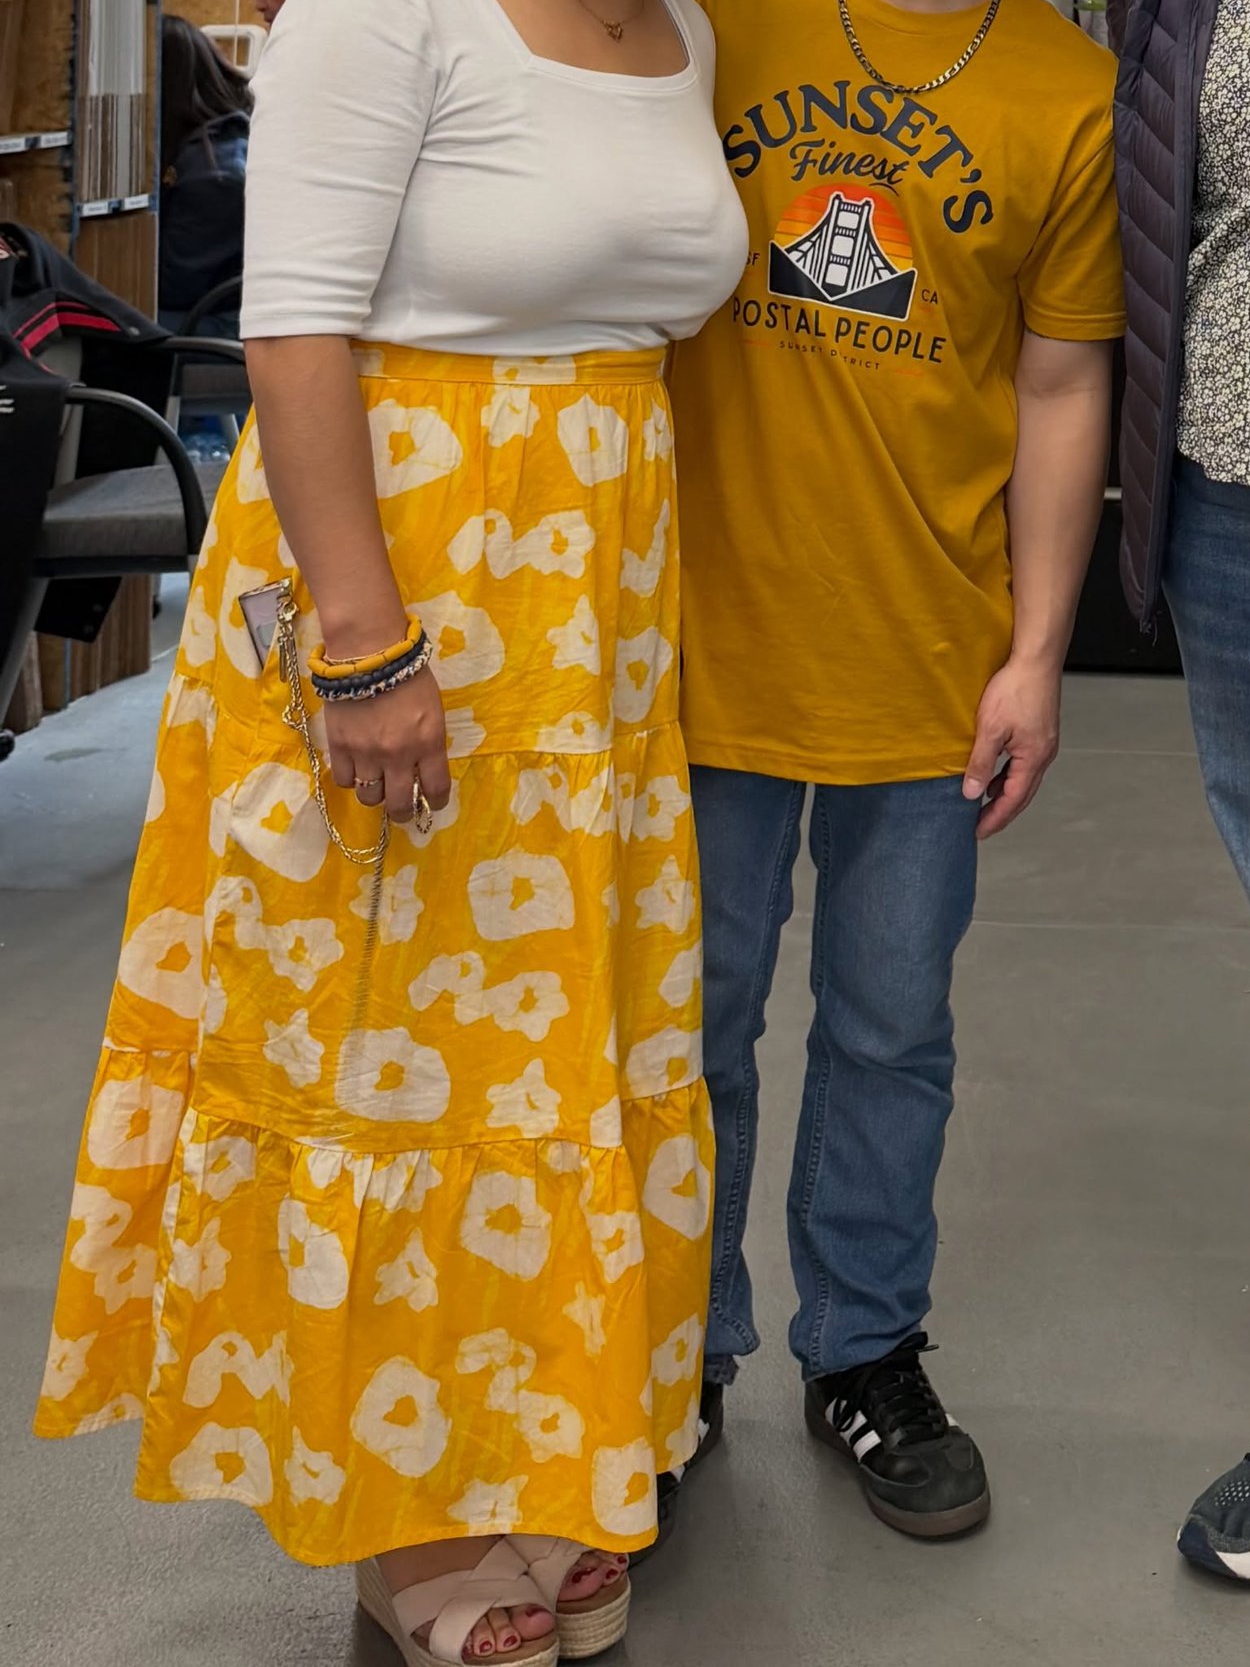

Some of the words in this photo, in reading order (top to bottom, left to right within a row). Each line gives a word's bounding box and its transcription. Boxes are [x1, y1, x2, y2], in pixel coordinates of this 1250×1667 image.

[723, 80, 994, 234] SUNSET'S
[790, 138, 910, 185] Finest
[921, 289, 939, 305] CA
[732, 297, 827, 338] POSTAL
[834, 317, 947, 364] PEOPLE
